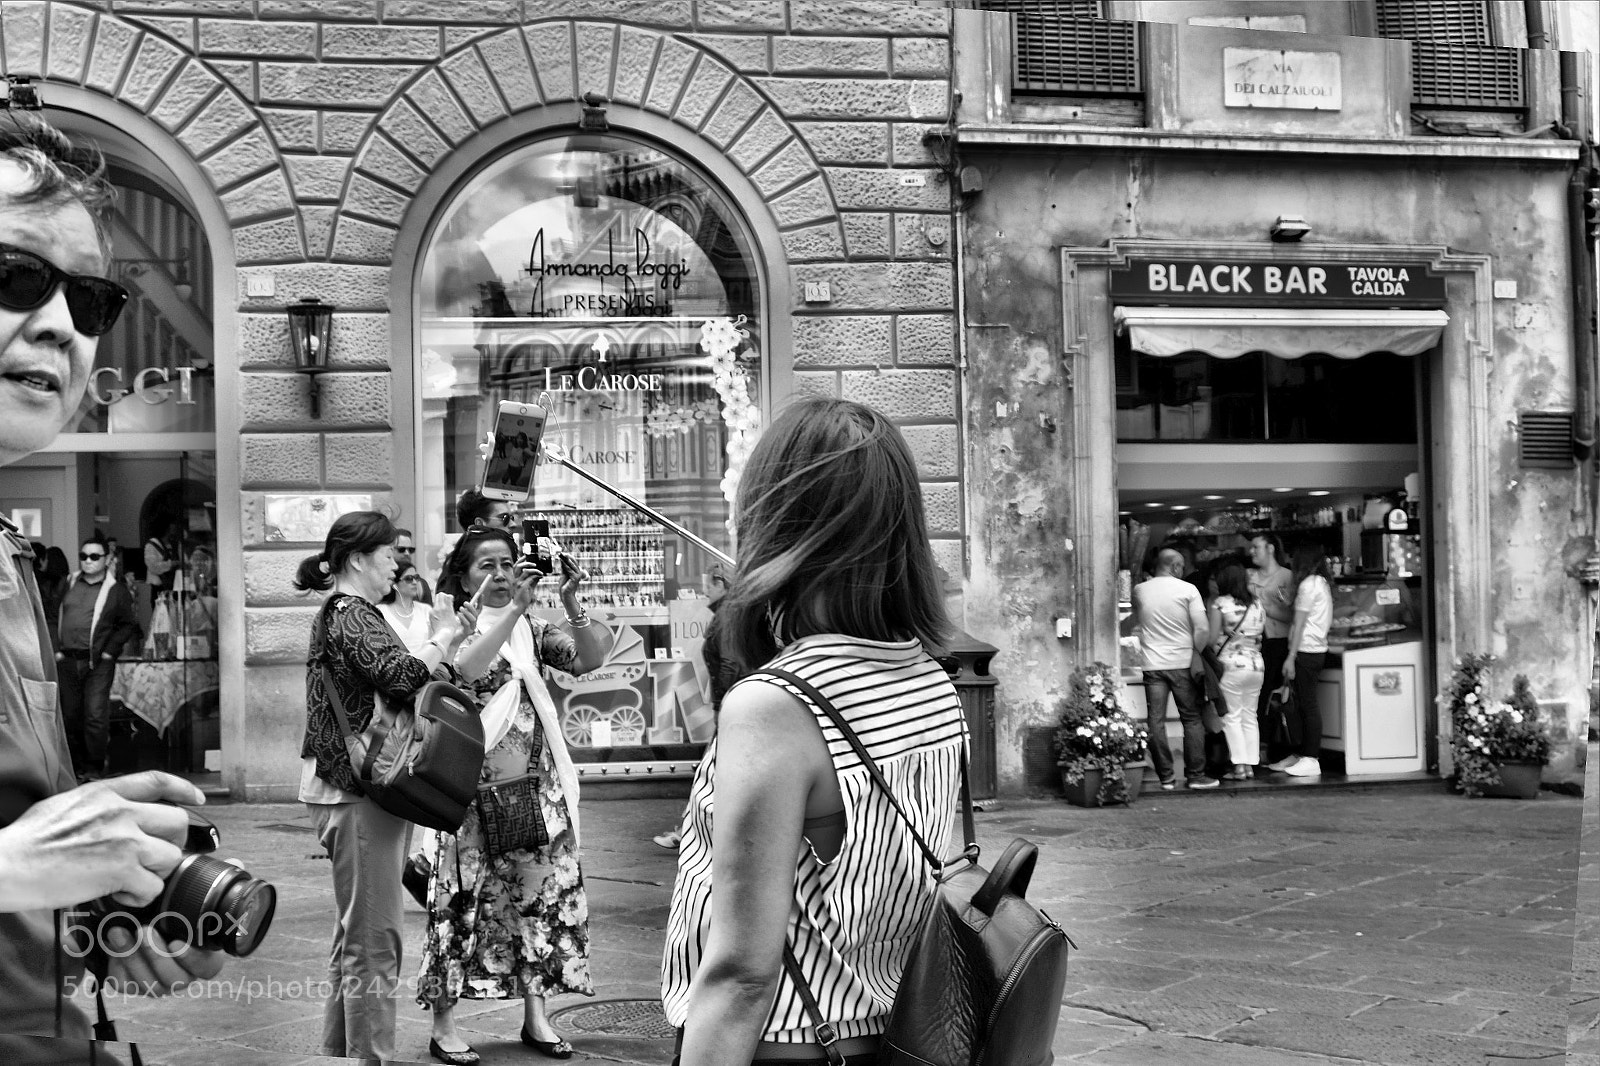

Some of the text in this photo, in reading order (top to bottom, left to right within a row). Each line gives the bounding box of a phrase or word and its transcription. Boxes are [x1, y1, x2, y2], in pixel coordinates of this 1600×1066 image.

[1273, 63, 1293, 74] VIA
[1234, 82, 1255, 94] DEI
[525, 227, 690, 290] Armando Poggi
[1148, 263, 1327, 294] BLACK BAR
[1347, 267, 1410, 282] TAVOLA
[1351, 281, 1406, 296] CALDA
[564, 294, 654, 310] PRESENTS
[88, 367, 196, 405] GGI
[543, 366, 663, 392] LE CAROSE
[682, 621, 708, 639] LOV
